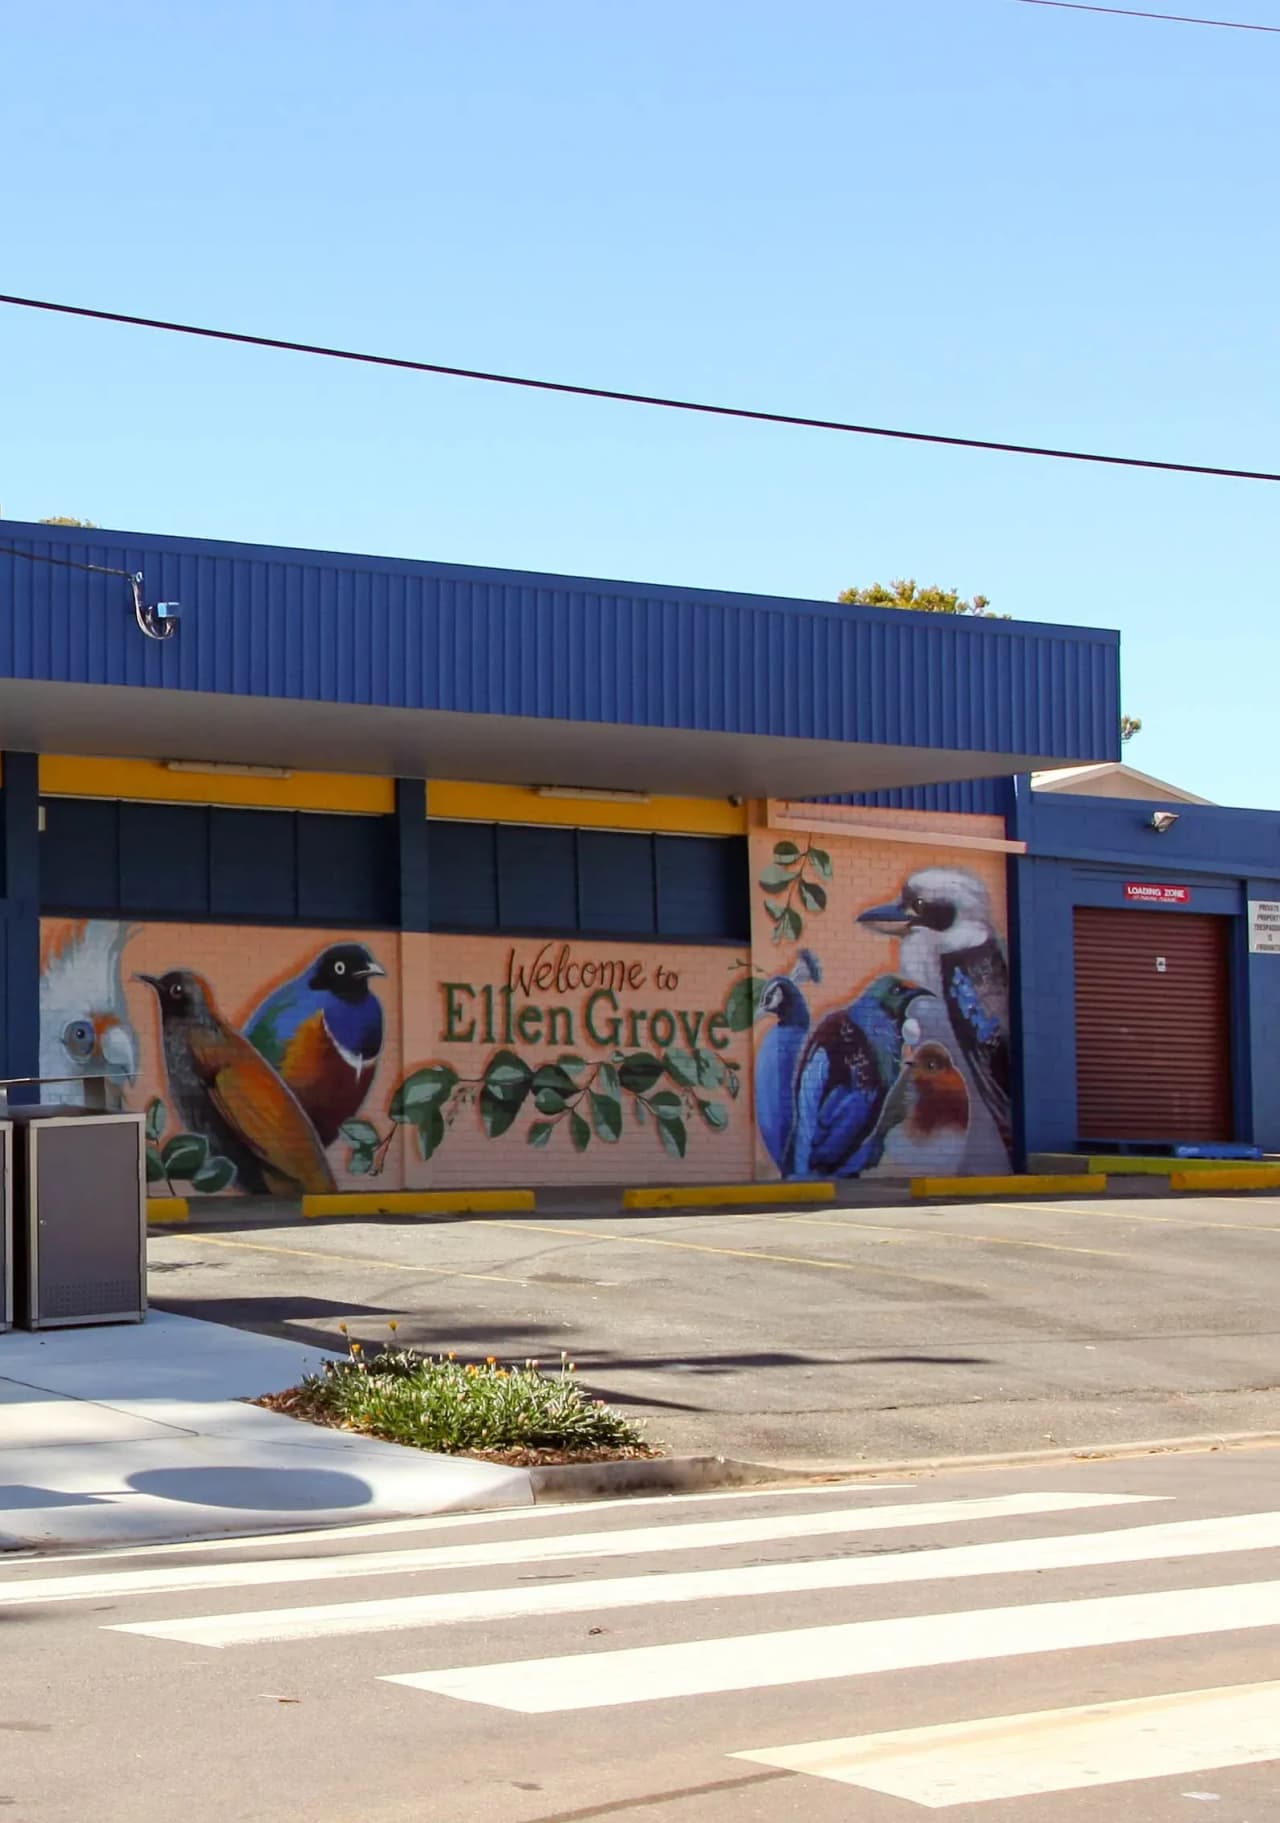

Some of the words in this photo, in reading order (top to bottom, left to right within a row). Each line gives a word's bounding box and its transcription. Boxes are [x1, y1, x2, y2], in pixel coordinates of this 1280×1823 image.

[1127, 886, 1161, 897] LOADING
[1164, 888, 1185, 898] ZONE
[506, 942, 646, 997] Welcome
[656, 964, 679, 991] to
[440, 981, 574, 1045] Ellen
[585, 988, 730, 1049] Grove
